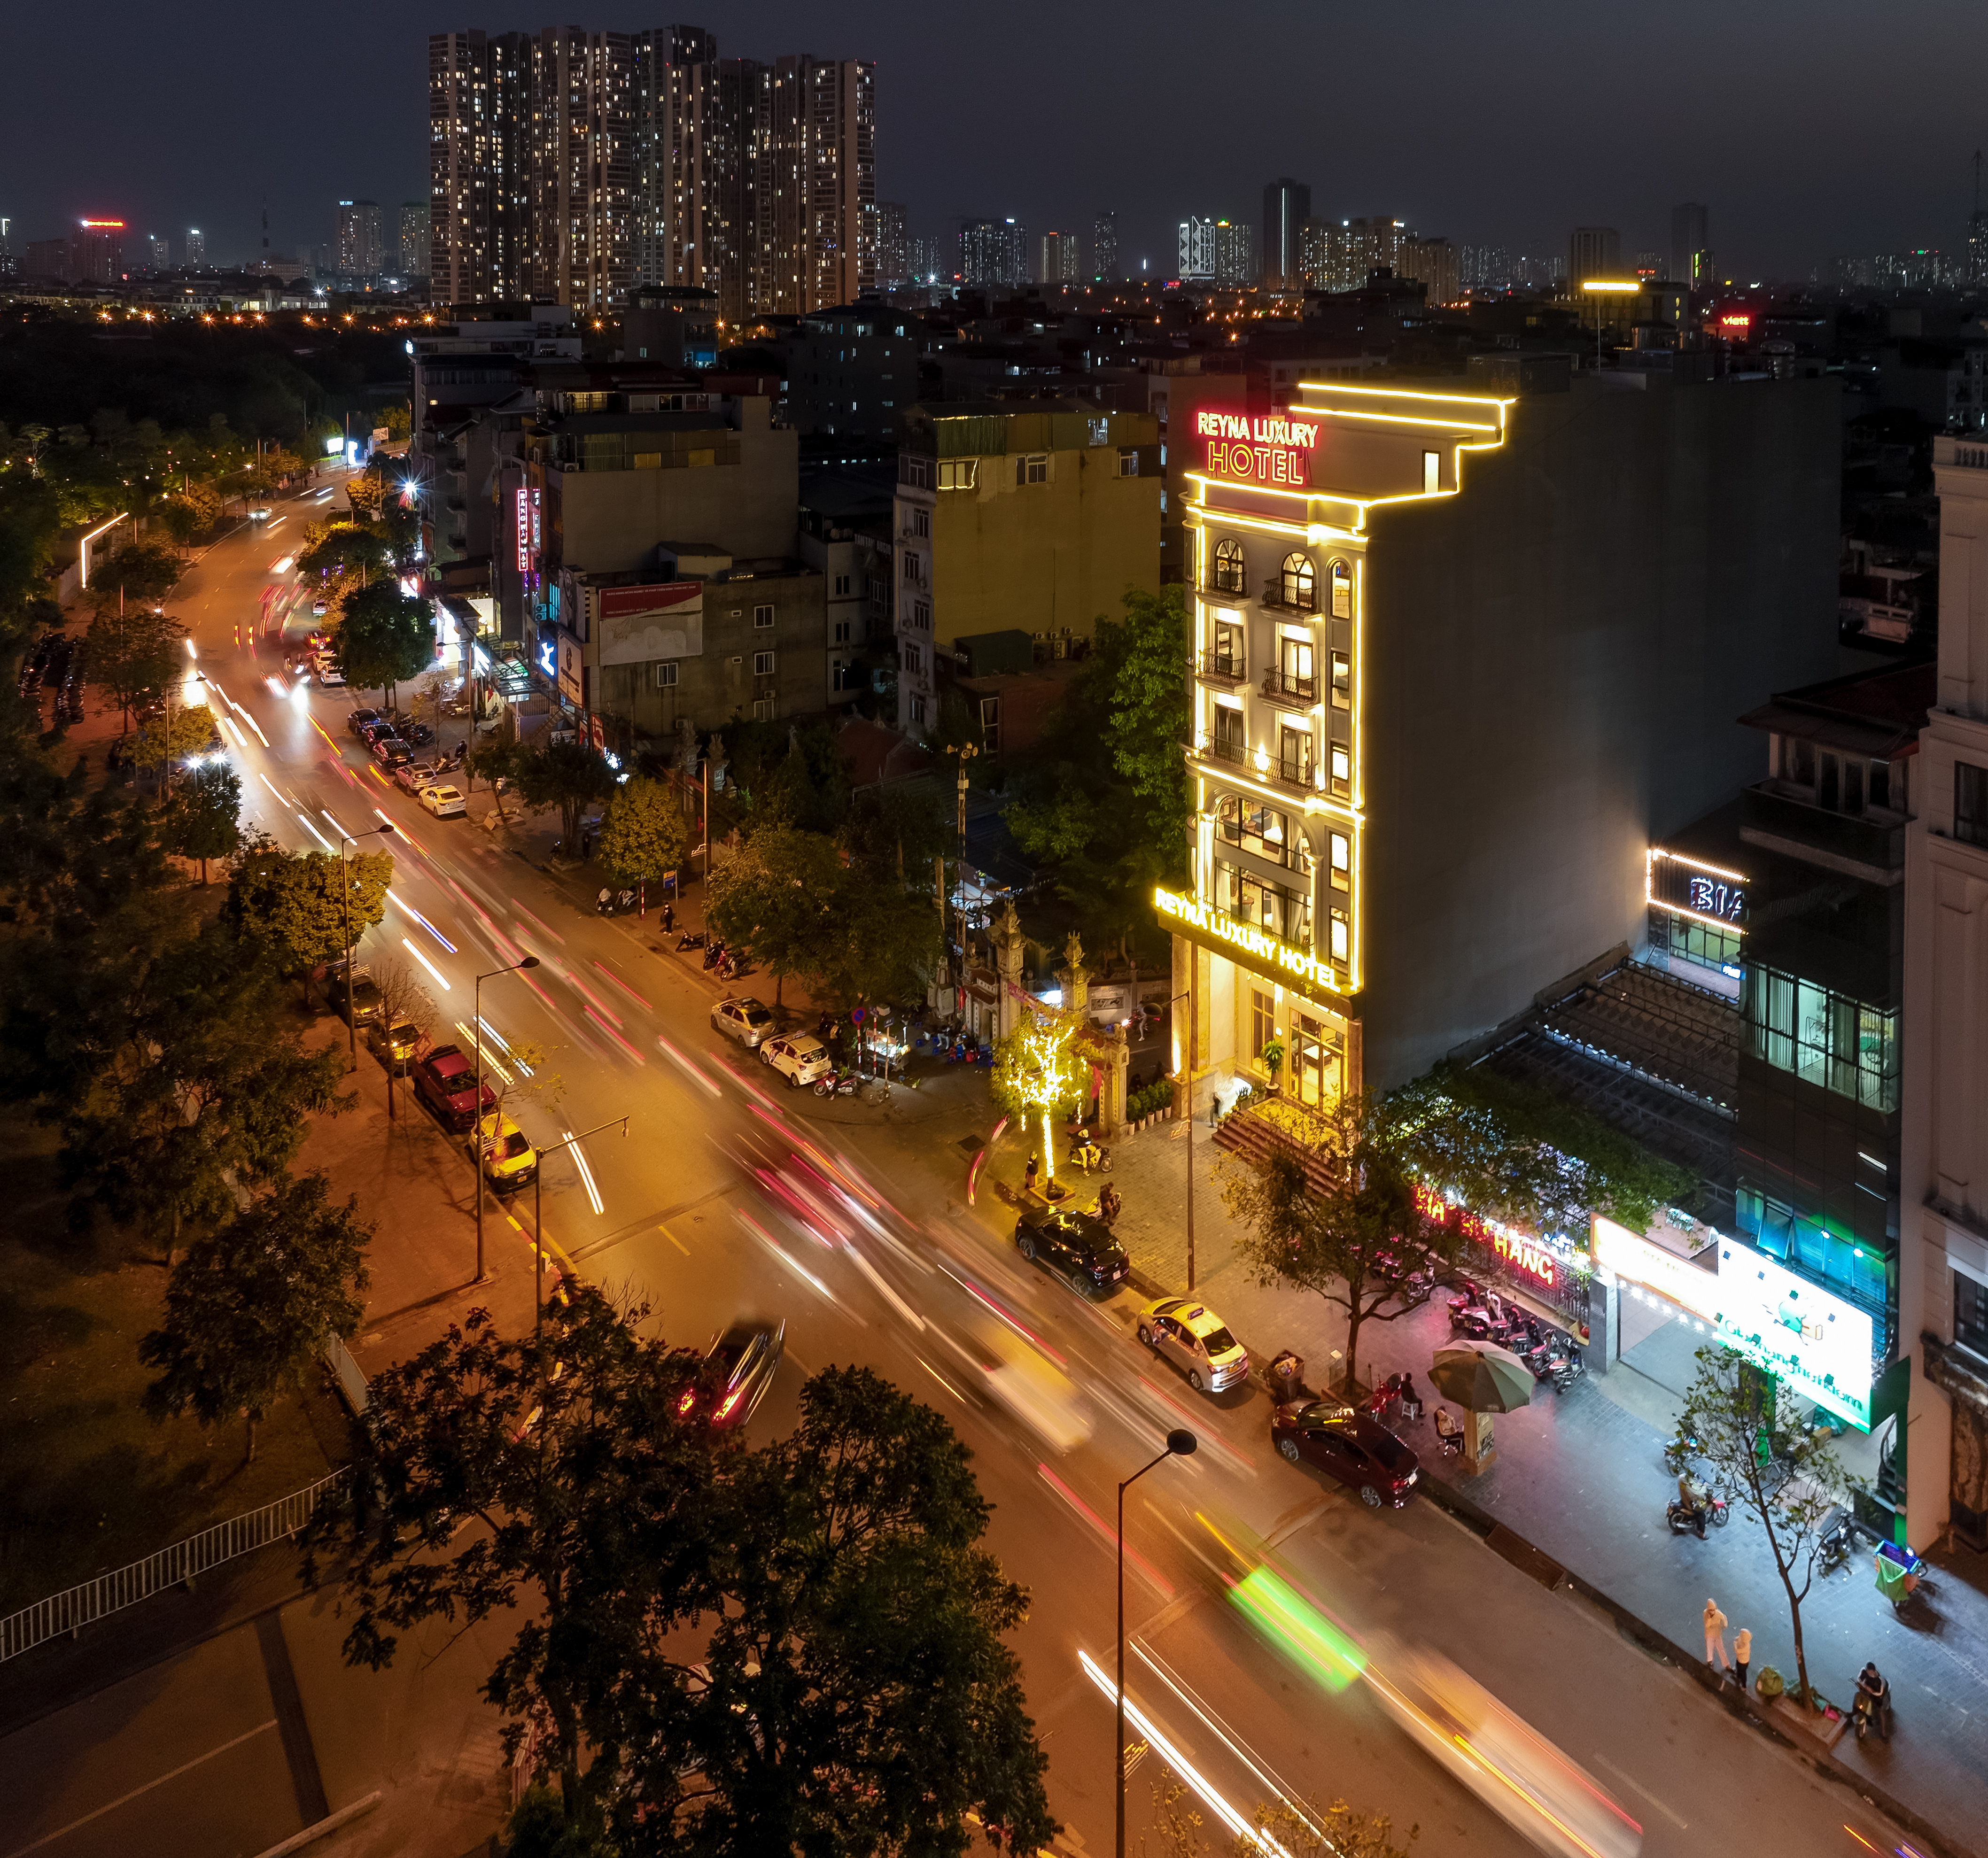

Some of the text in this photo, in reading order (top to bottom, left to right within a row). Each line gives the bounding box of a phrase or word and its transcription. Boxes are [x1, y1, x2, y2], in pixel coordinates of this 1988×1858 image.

[1198, 411, 1319, 448] REYNA LUXURY
[1208, 441, 1303, 485] HOTEL
[1155, 887, 1341, 992] REYNA LUXURY HOTEL
